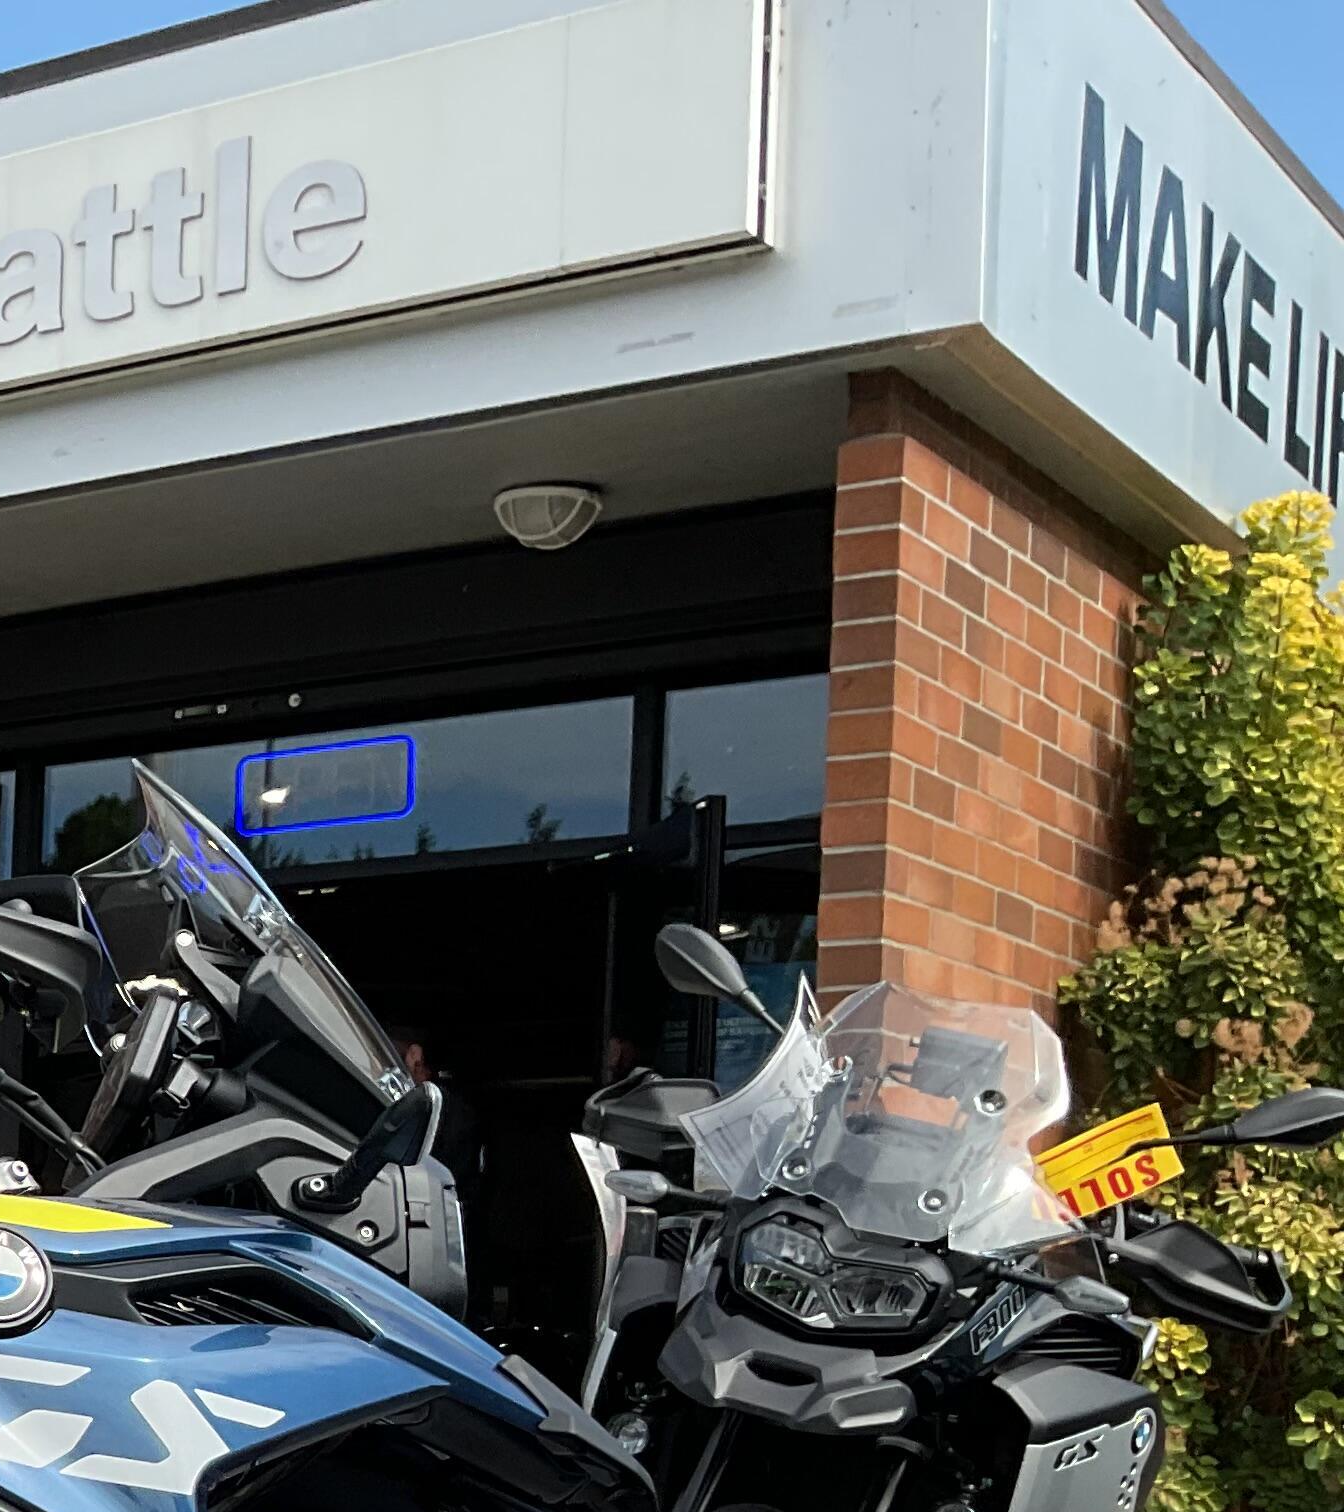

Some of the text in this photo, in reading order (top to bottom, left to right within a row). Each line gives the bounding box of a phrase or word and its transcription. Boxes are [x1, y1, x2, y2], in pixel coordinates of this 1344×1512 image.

[1075, 84, 1276, 444] MAKE
[970, 1285, 1026, 1356] F900
[1054, 1434, 1104, 1472] GS
